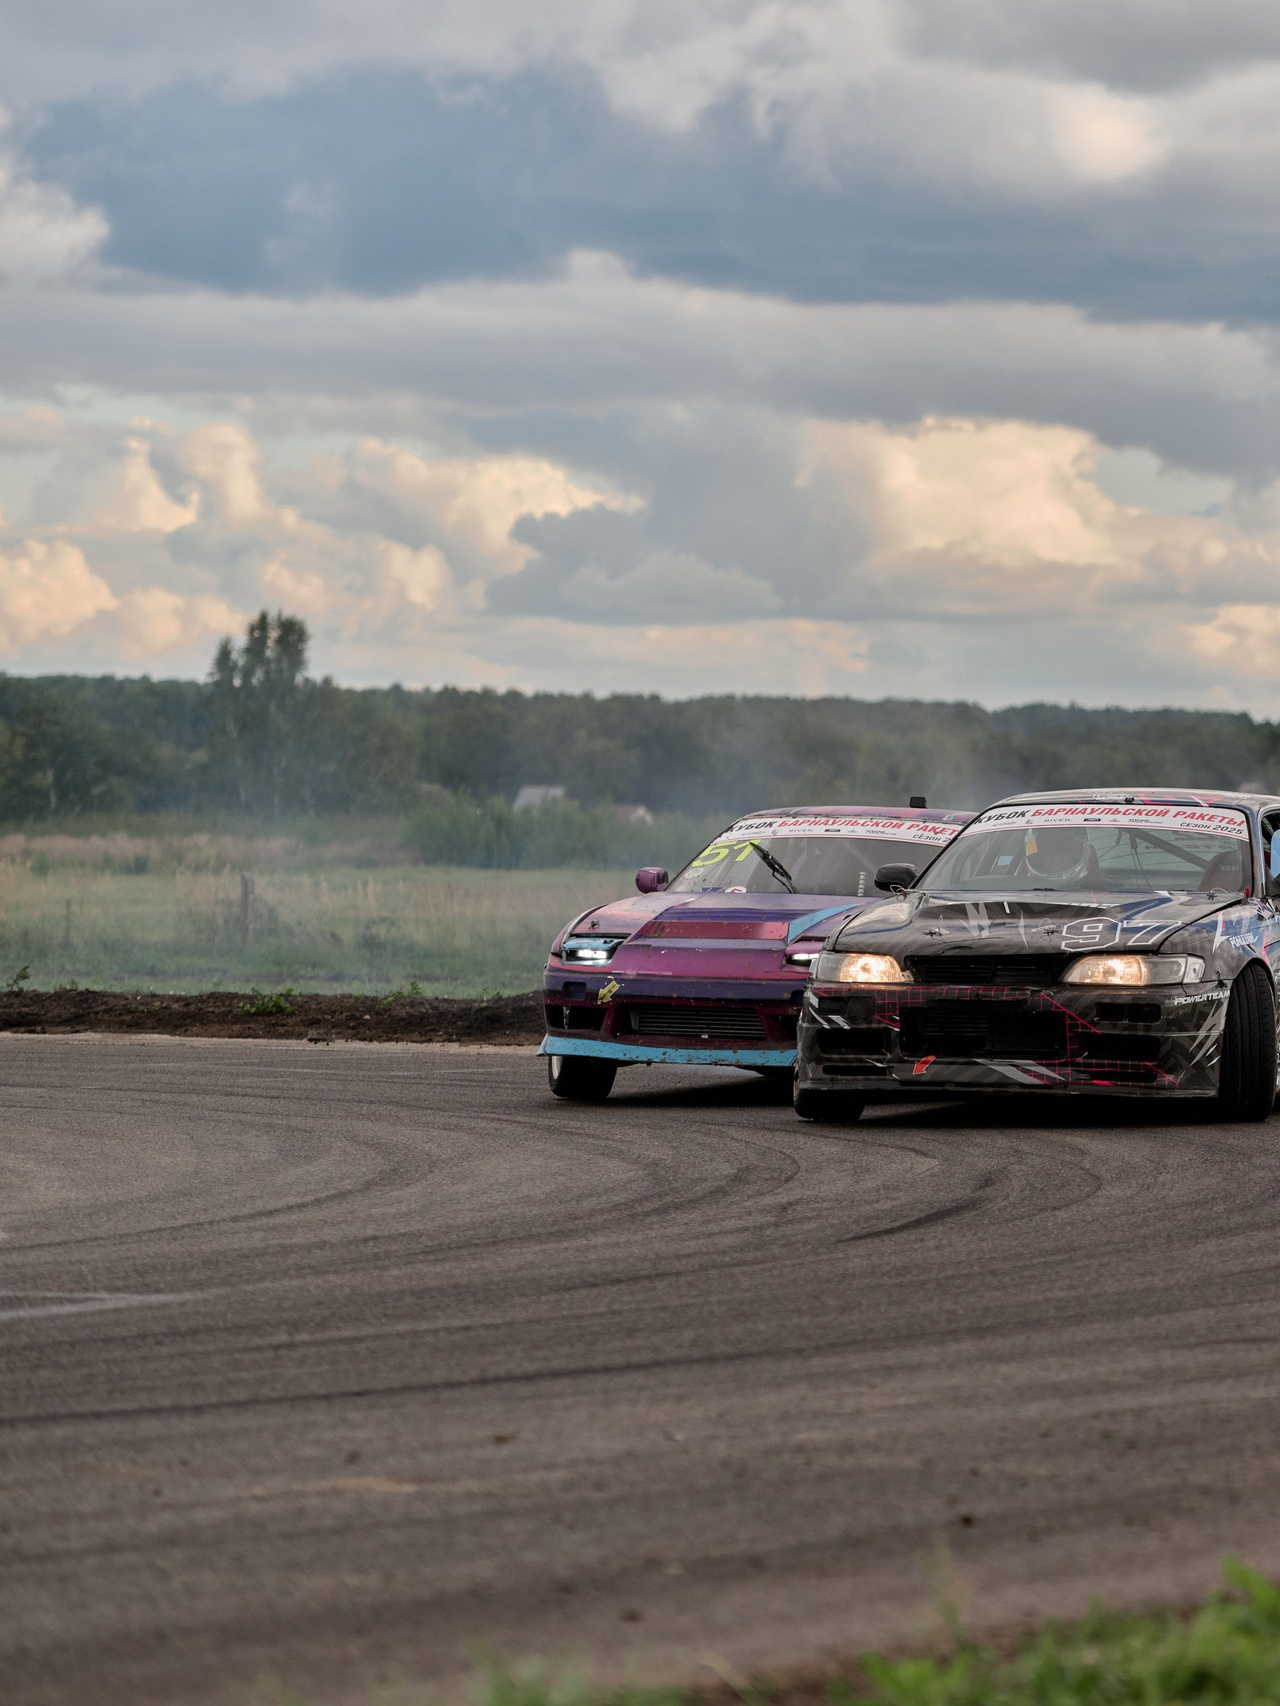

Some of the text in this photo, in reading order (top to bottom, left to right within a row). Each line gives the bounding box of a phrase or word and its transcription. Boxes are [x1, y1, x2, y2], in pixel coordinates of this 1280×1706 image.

[973, 810, 1031, 825] КУБОК
[1031, 807, 1171, 819] БАРНАУЛЬСКОЙ
[1172, 810, 1246, 828] РАКЕТЫ
[1180, 821, 1245, 835] СЕЗОН 2025
[906, 823, 960, 836] РАКЕТ
[692, 839, 761, 868] 51
[1061, 916, 1182, 951] 97
